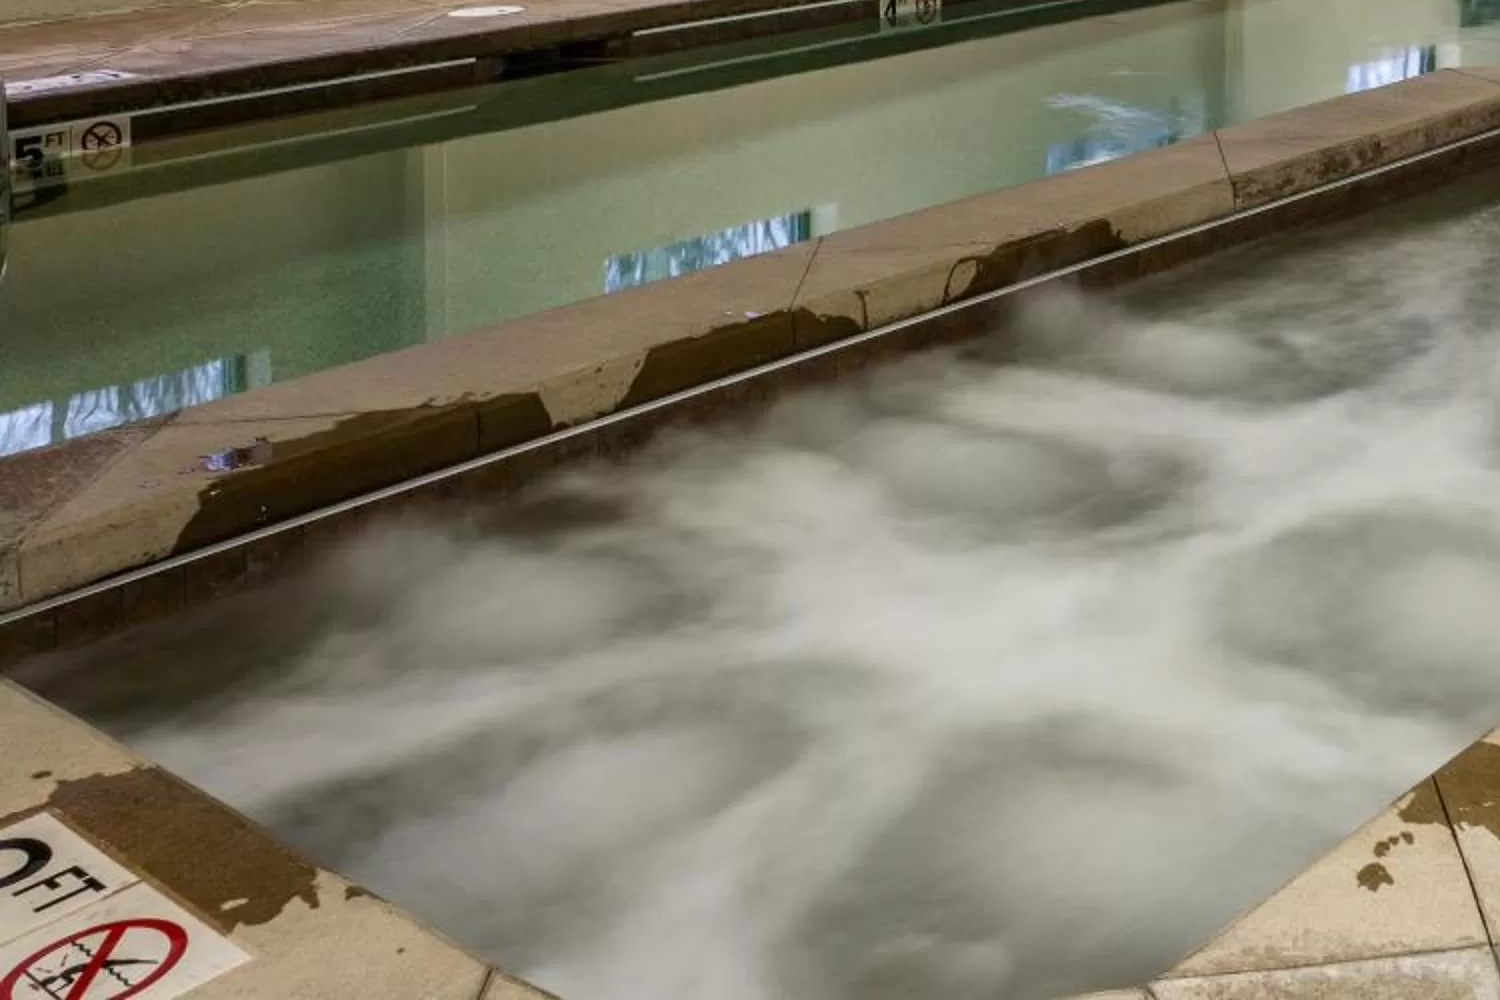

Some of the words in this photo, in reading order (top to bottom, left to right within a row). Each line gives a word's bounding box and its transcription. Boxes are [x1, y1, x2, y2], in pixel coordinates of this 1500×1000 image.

[16, 136, 44, 168] 5
[45, 131, 65, 147] FT
[12, 865, 107, 913] FT
